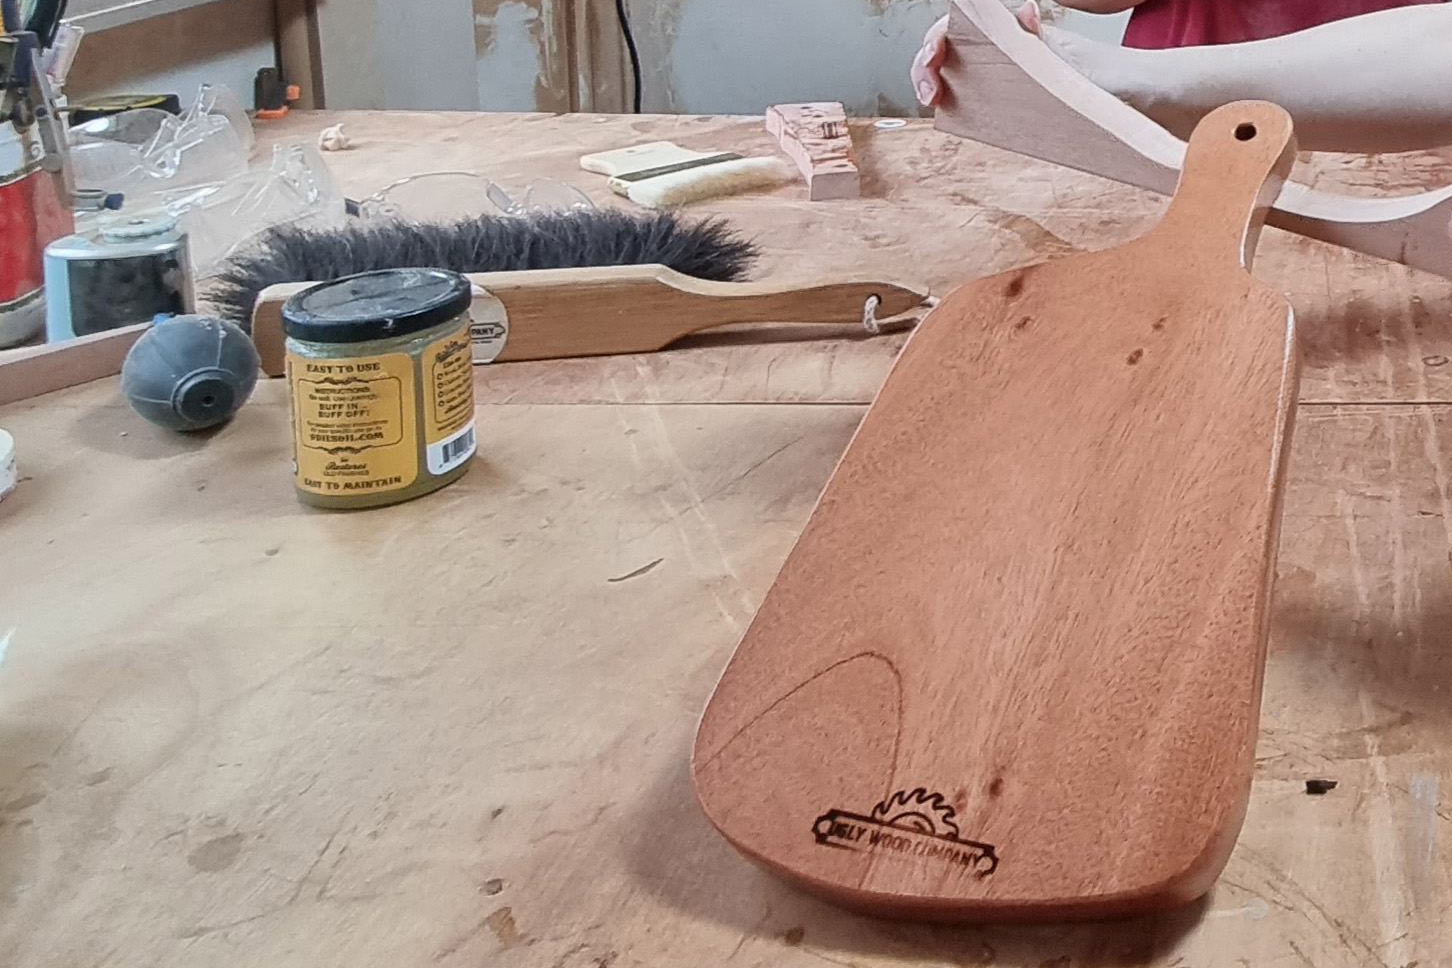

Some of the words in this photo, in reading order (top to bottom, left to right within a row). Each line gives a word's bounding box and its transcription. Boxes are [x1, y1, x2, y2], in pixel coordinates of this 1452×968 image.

[306, 364, 333, 374] EASY
[336, 365, 354, 373] TO
[357, 363, 381, 372] USE
[325, 482, 340, 490] TO
[343, 476, 402, 490] MAINTAIN
[828, 822, 867, 842] UGLY
[869, 830, 912, 854] WOOD
